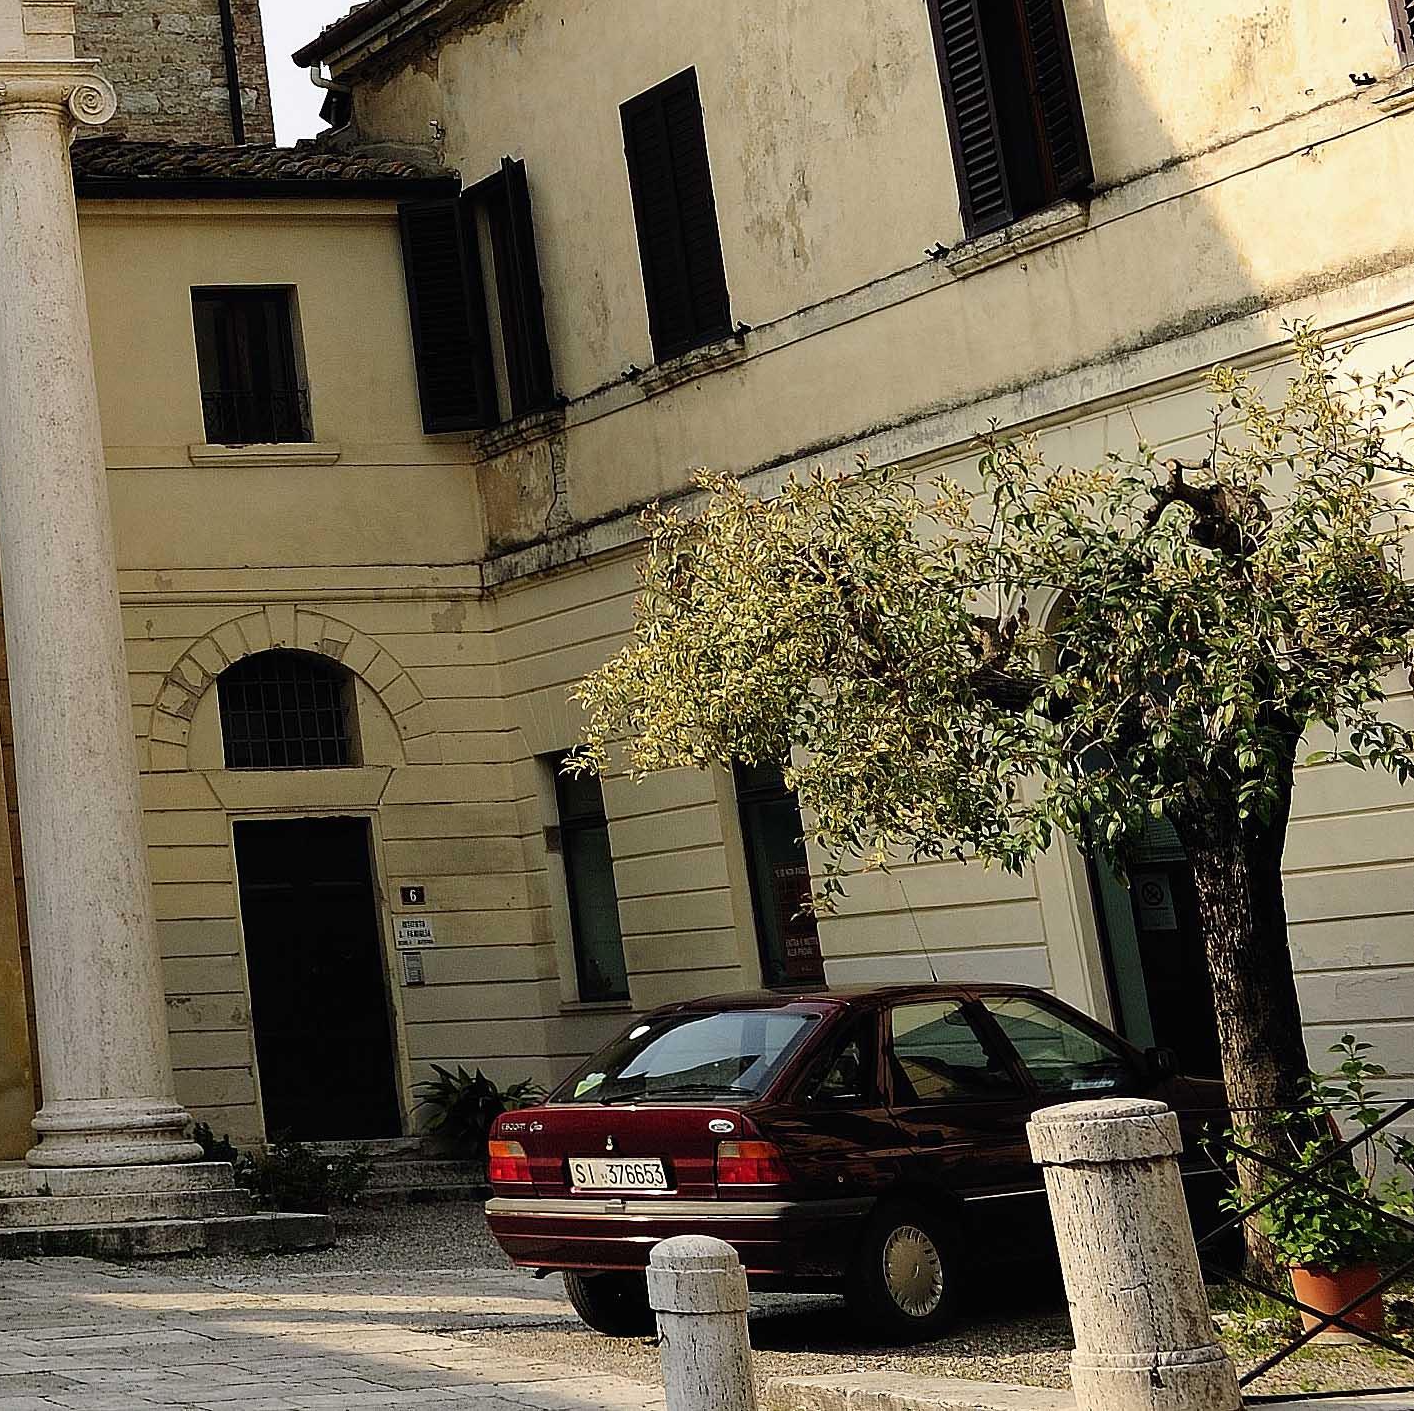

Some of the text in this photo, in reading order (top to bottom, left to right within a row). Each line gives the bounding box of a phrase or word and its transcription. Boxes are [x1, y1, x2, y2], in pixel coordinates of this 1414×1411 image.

[409, 889, 417, 901] 6
[575, 1163, 664, 1185] SI 376653
